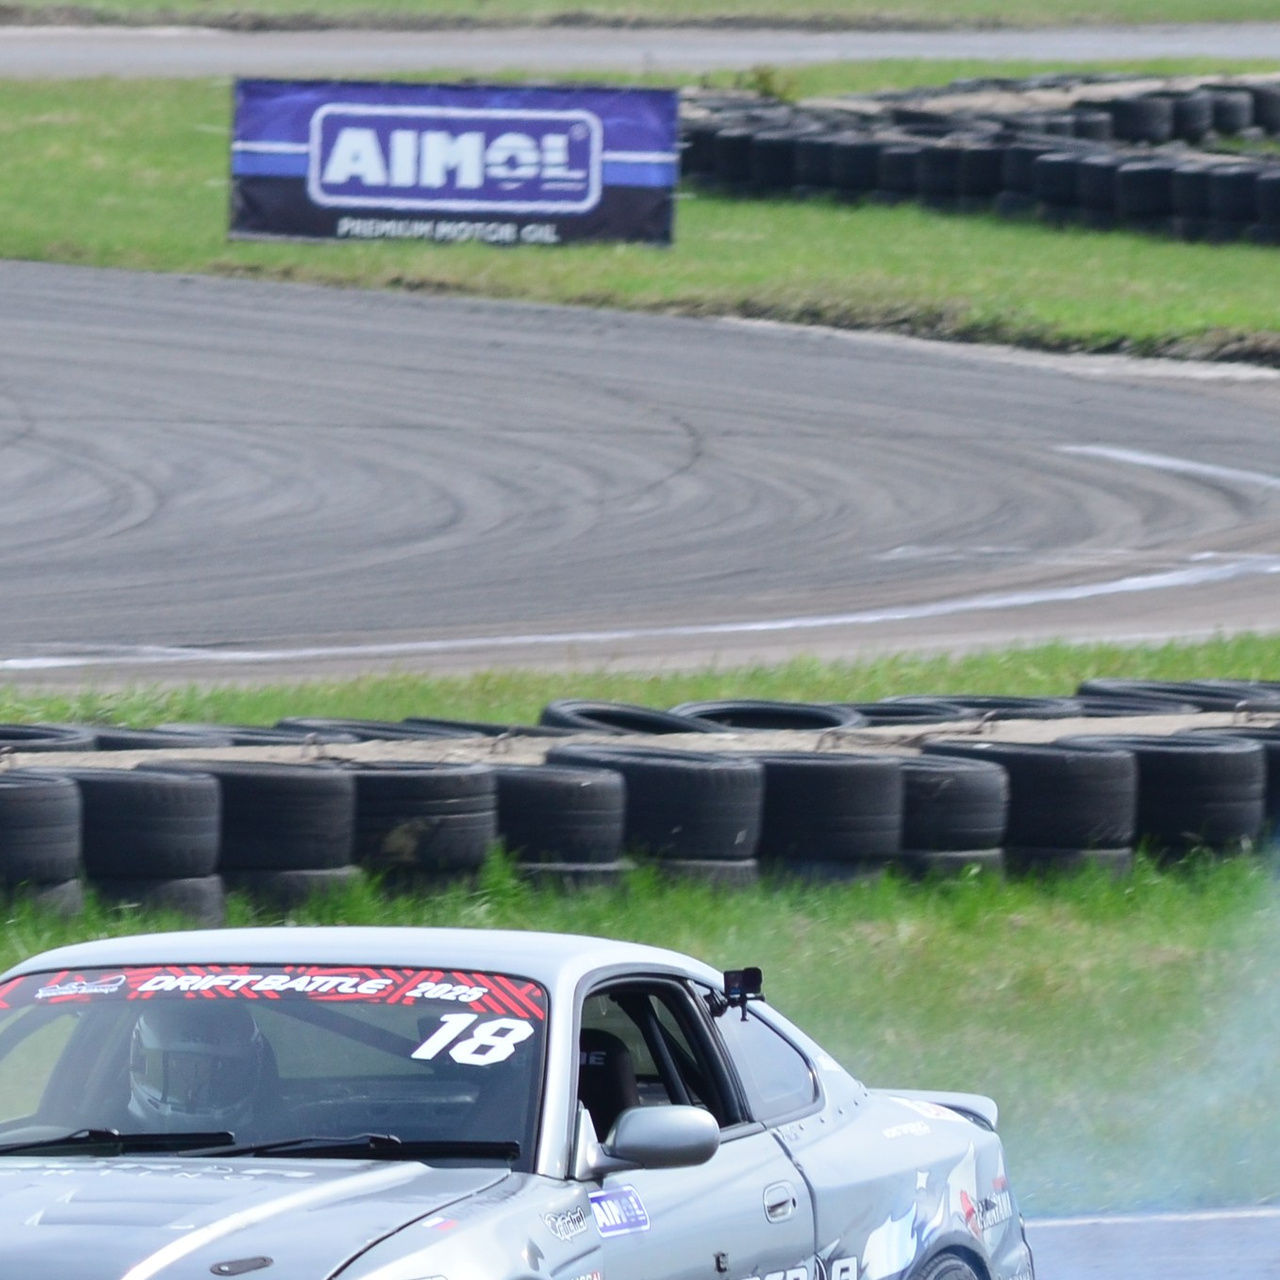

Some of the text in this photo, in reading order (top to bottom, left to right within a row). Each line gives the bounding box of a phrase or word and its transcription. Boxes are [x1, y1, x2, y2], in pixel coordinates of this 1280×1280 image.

[322, 126, 587, 192] AIMOL
[337, 217, 560, 243] PREMIUM MOTOR OIL
[137, 975, 264, 991] DRIFT
[251, 975, 393, 994] BATTLE
[406, 981, 488, 1002] 2025
[411, 1013, 535, 1066] 18
